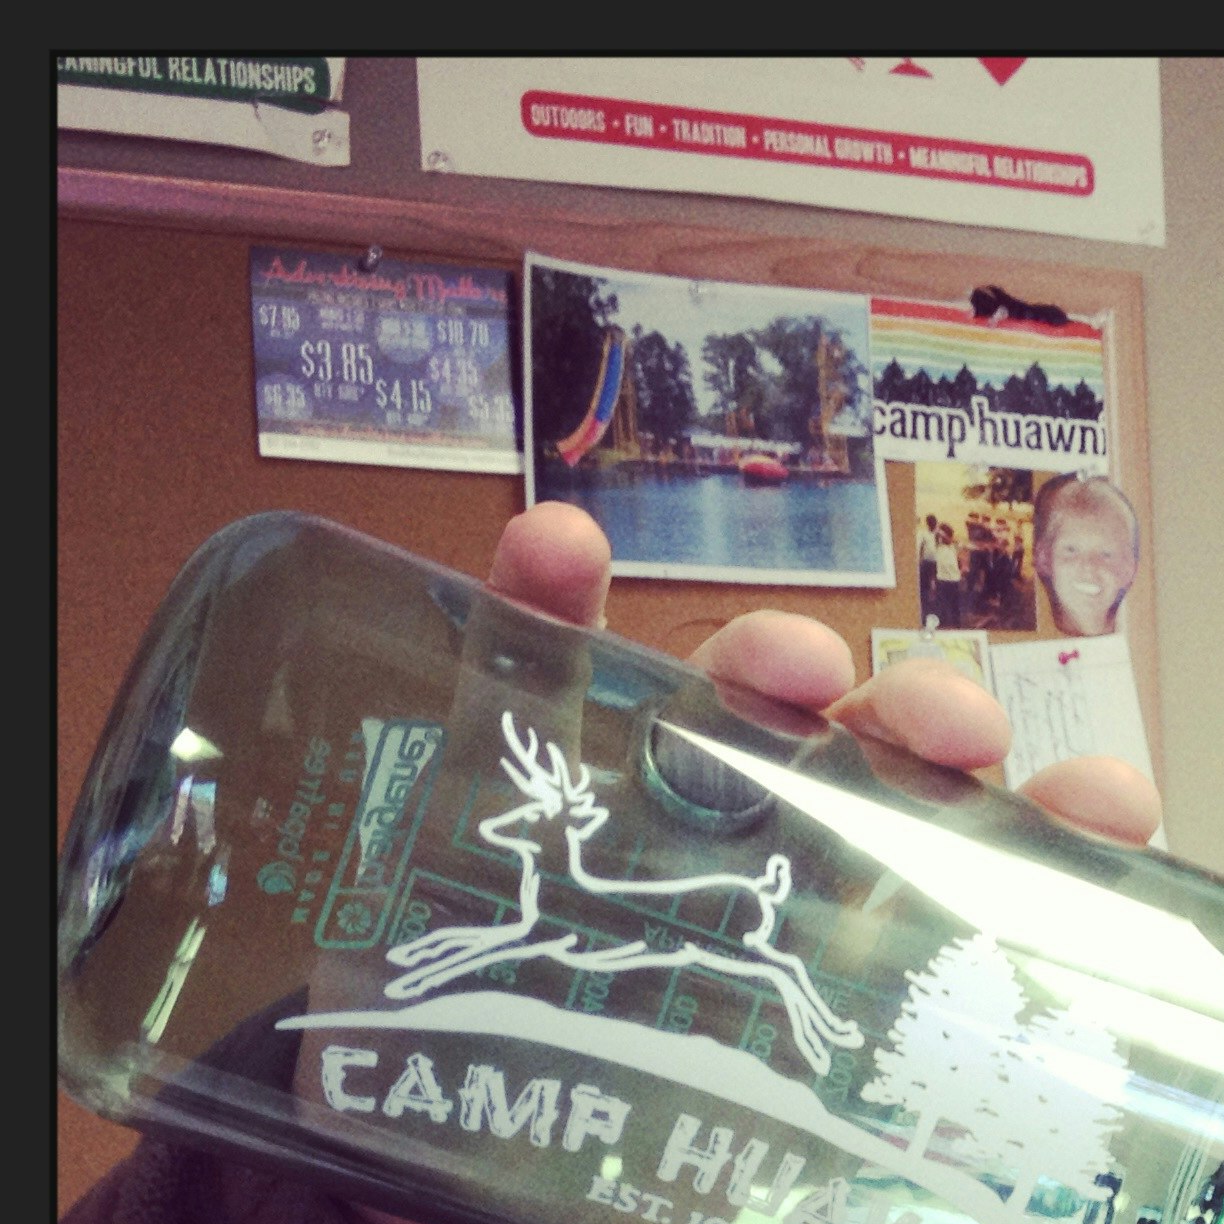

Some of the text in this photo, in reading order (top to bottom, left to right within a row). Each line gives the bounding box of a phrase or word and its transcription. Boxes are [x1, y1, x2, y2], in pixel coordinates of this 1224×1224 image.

[167, 57, 315, 94] RELATIONSHIPS
[530, 102, 1089, 188] OUTDOORS FUN TRADITION PERSONAL GROWTH MEANINGFUL RELATIONSHIPS
[874, 405, 967, 458] camp
[321, 1045, 632, 1152] CAMP
